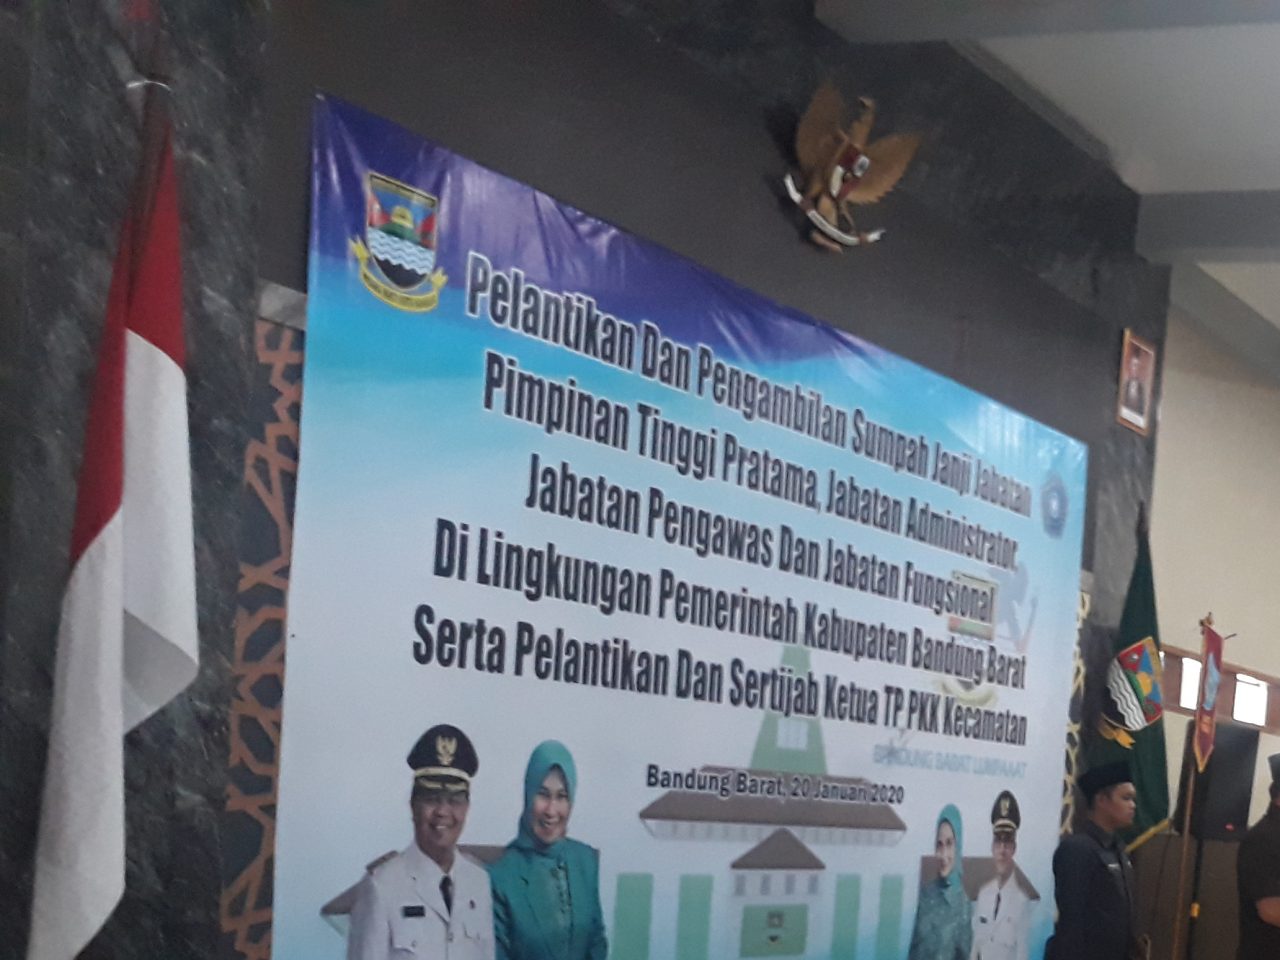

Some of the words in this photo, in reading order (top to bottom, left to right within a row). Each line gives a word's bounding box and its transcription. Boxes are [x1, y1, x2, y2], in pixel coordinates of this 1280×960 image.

[467, 250, 636, 372] Pelantikan
[640, 320, 692, 392] Dan
[697, 343, 848, 448] Pengambilan
[851, 407, 929, 477] Sumpah
[932, 439, 973, 498] Janji
[484, 350, 629, 451] Pimpinan
[637, 402, 717, 480] Tinggi
[722, 433, 822, 514] Pratama,
[826, 469, 902, 541] Jabatan
[433, 517, 469, 581] Di
[477, 527, 650, 616] Lingkungan
[658, 568, 798, 646] Pemerintah
[803, 601, 907, 667] Kabupaten
[911, 627, 984, 686] Bandung
[987, 645, 1027, 690] Barat
[525, 453, 641, 535] Jabatan
[647, 486, 774, 569] Pengawas
[778, 525, 820, 579] Dan
[824, 538, 900, 600] Jabatan
[904, 561, 996, 625] Fungsional
[413, 603, 507, 675] Serta
[514, 621, 671, 697] Pelantikan
[675, 648, 723, 704] Dan
[729, 657, 819, 718] Sertijab
[824, 674, 880, 727] Ketua
[884, 684, 905, 730] TP
[907, 690, 941, 735] PKK
[942, 696, 1028, 747] Kecamatan
[646, 764, 730, 797] Bandung
[791, 777, 811, 798] 20
[813, 778, 868, 802] Januari
[871, 784, 905, 805] 2020
